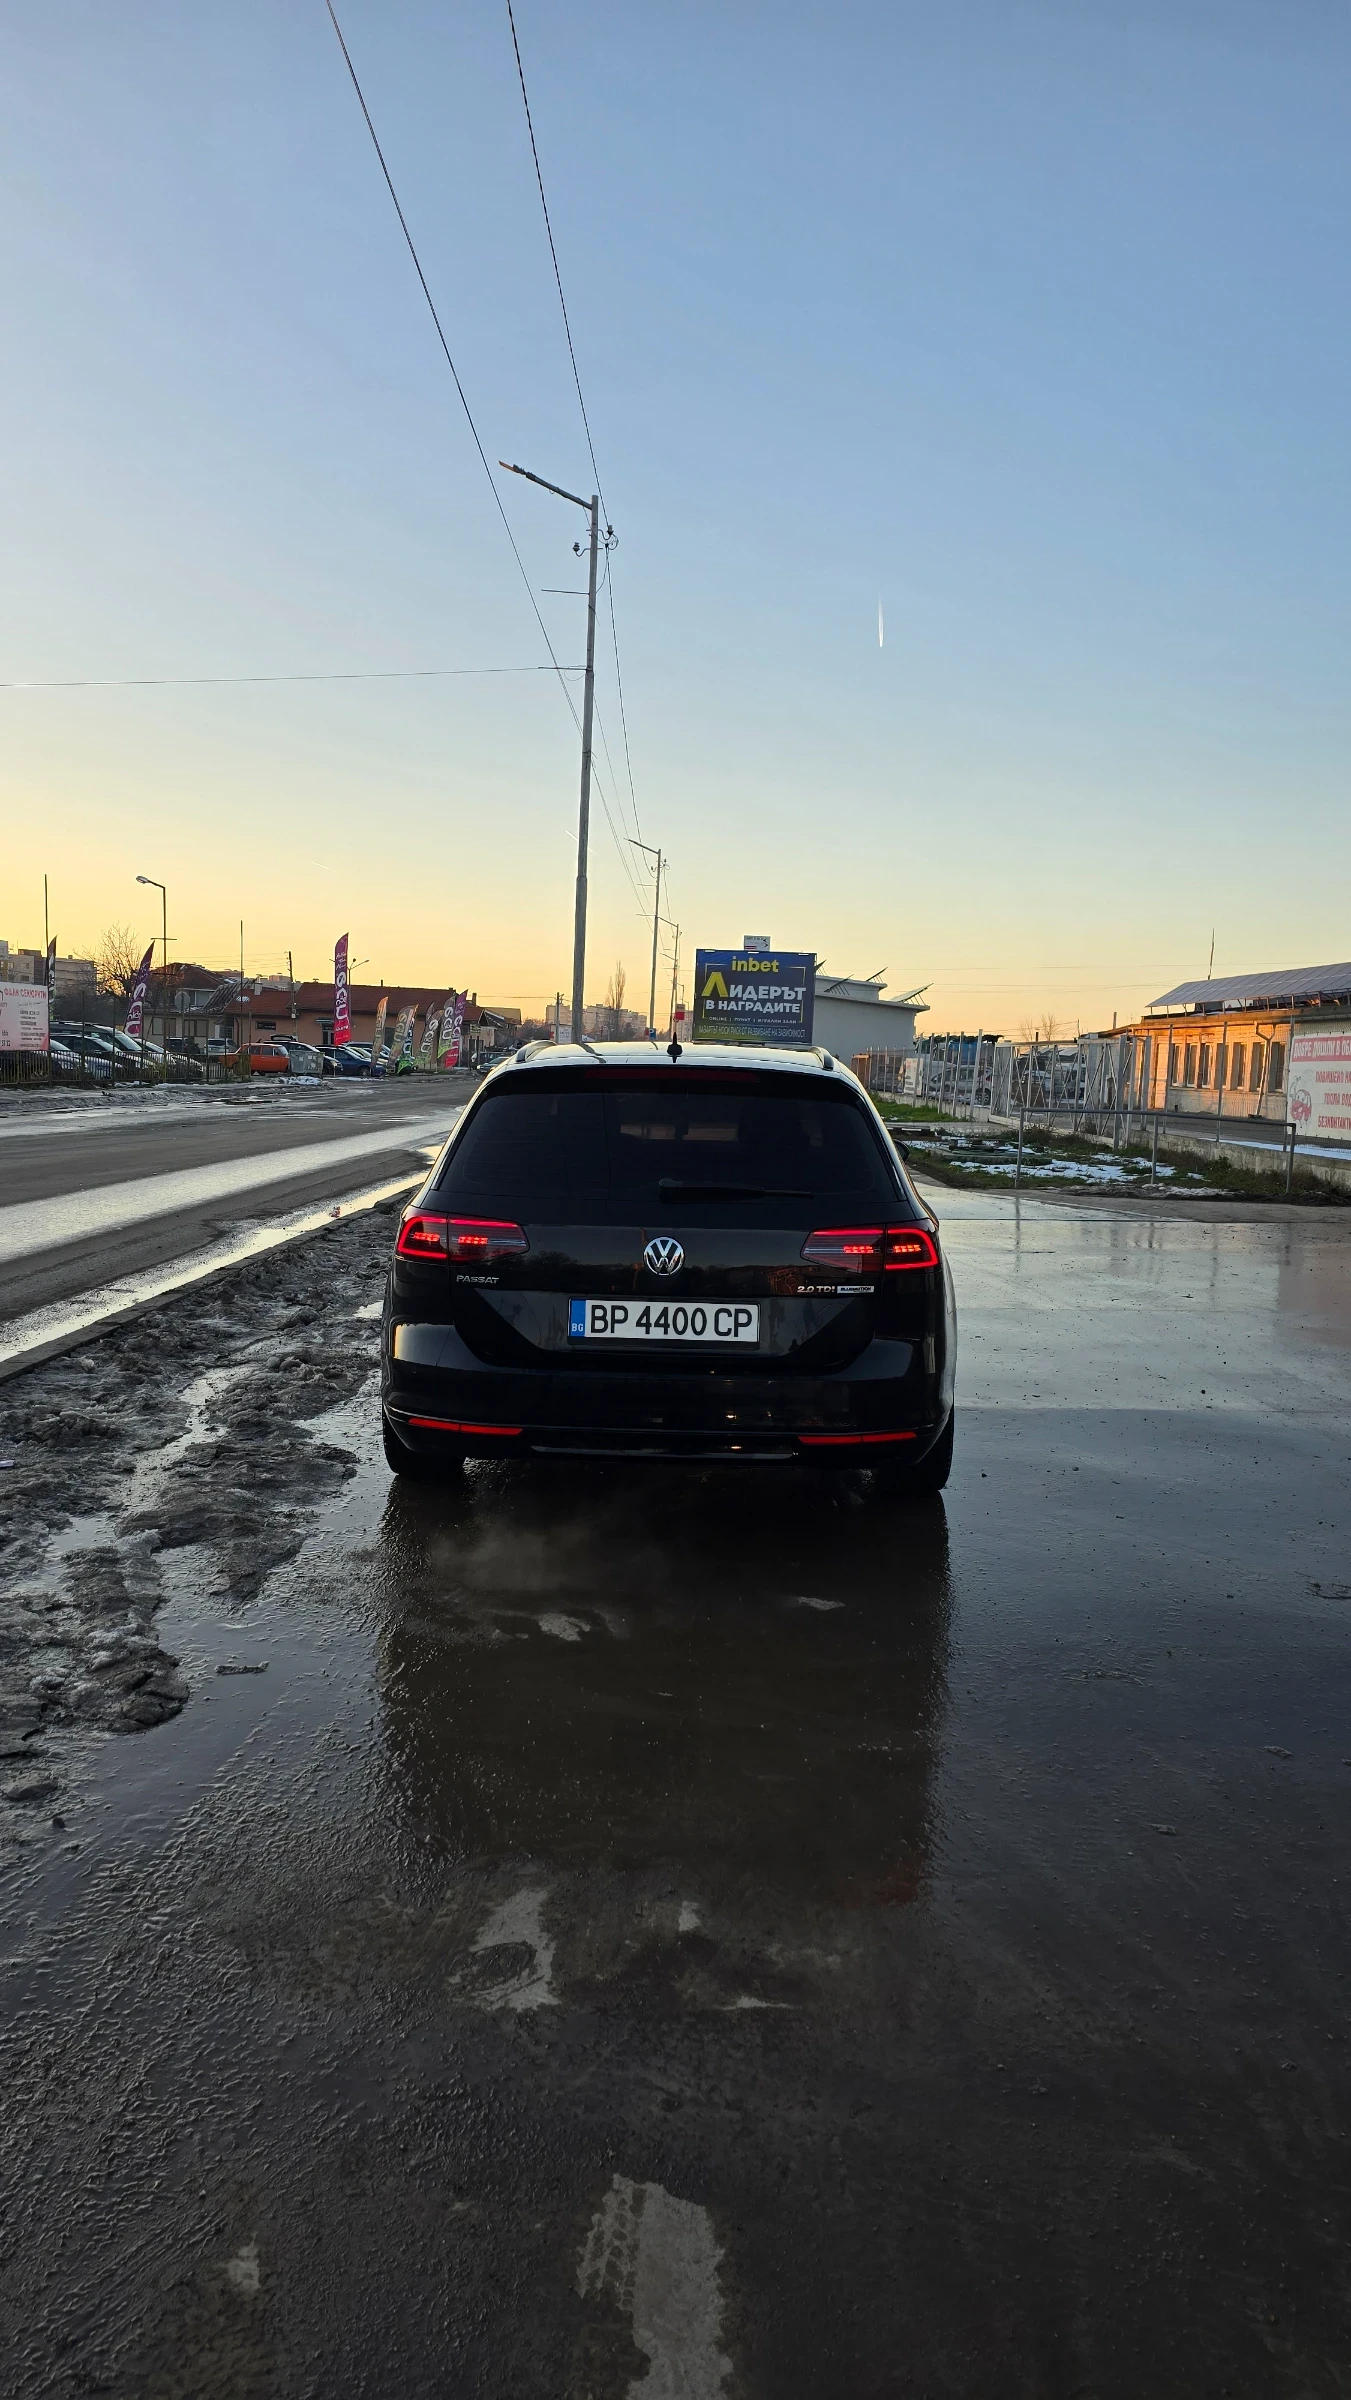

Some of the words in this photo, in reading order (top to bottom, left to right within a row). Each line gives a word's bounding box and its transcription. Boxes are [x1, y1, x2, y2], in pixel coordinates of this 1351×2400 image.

[732, 956, 779, 972] inbet
[701, 971, 806, 1001] ЛИДЕРЪТ
[705, 1000, 715, 1010] В
[718, 1001, 800, 1014] НАГРАДИТЕ
[1293, 1041, 1312, 1059] ДОБРЕ
[1312, 1040, 1335, 1058] ДОШЛИ
[1336, 1040, 1341, 1056] В
[456, 1275, 499, 1284] PASSAT
[797, 1285, 814, 1293] 2.0
[816, 1285, 835, 1293] TDI
[571, 1323, 584, 1332] BG
[590, 1305, 629, 1334] BP
[635, 1305, 707, 1336] 4400
[714, 1308, 752, 1337] CP
